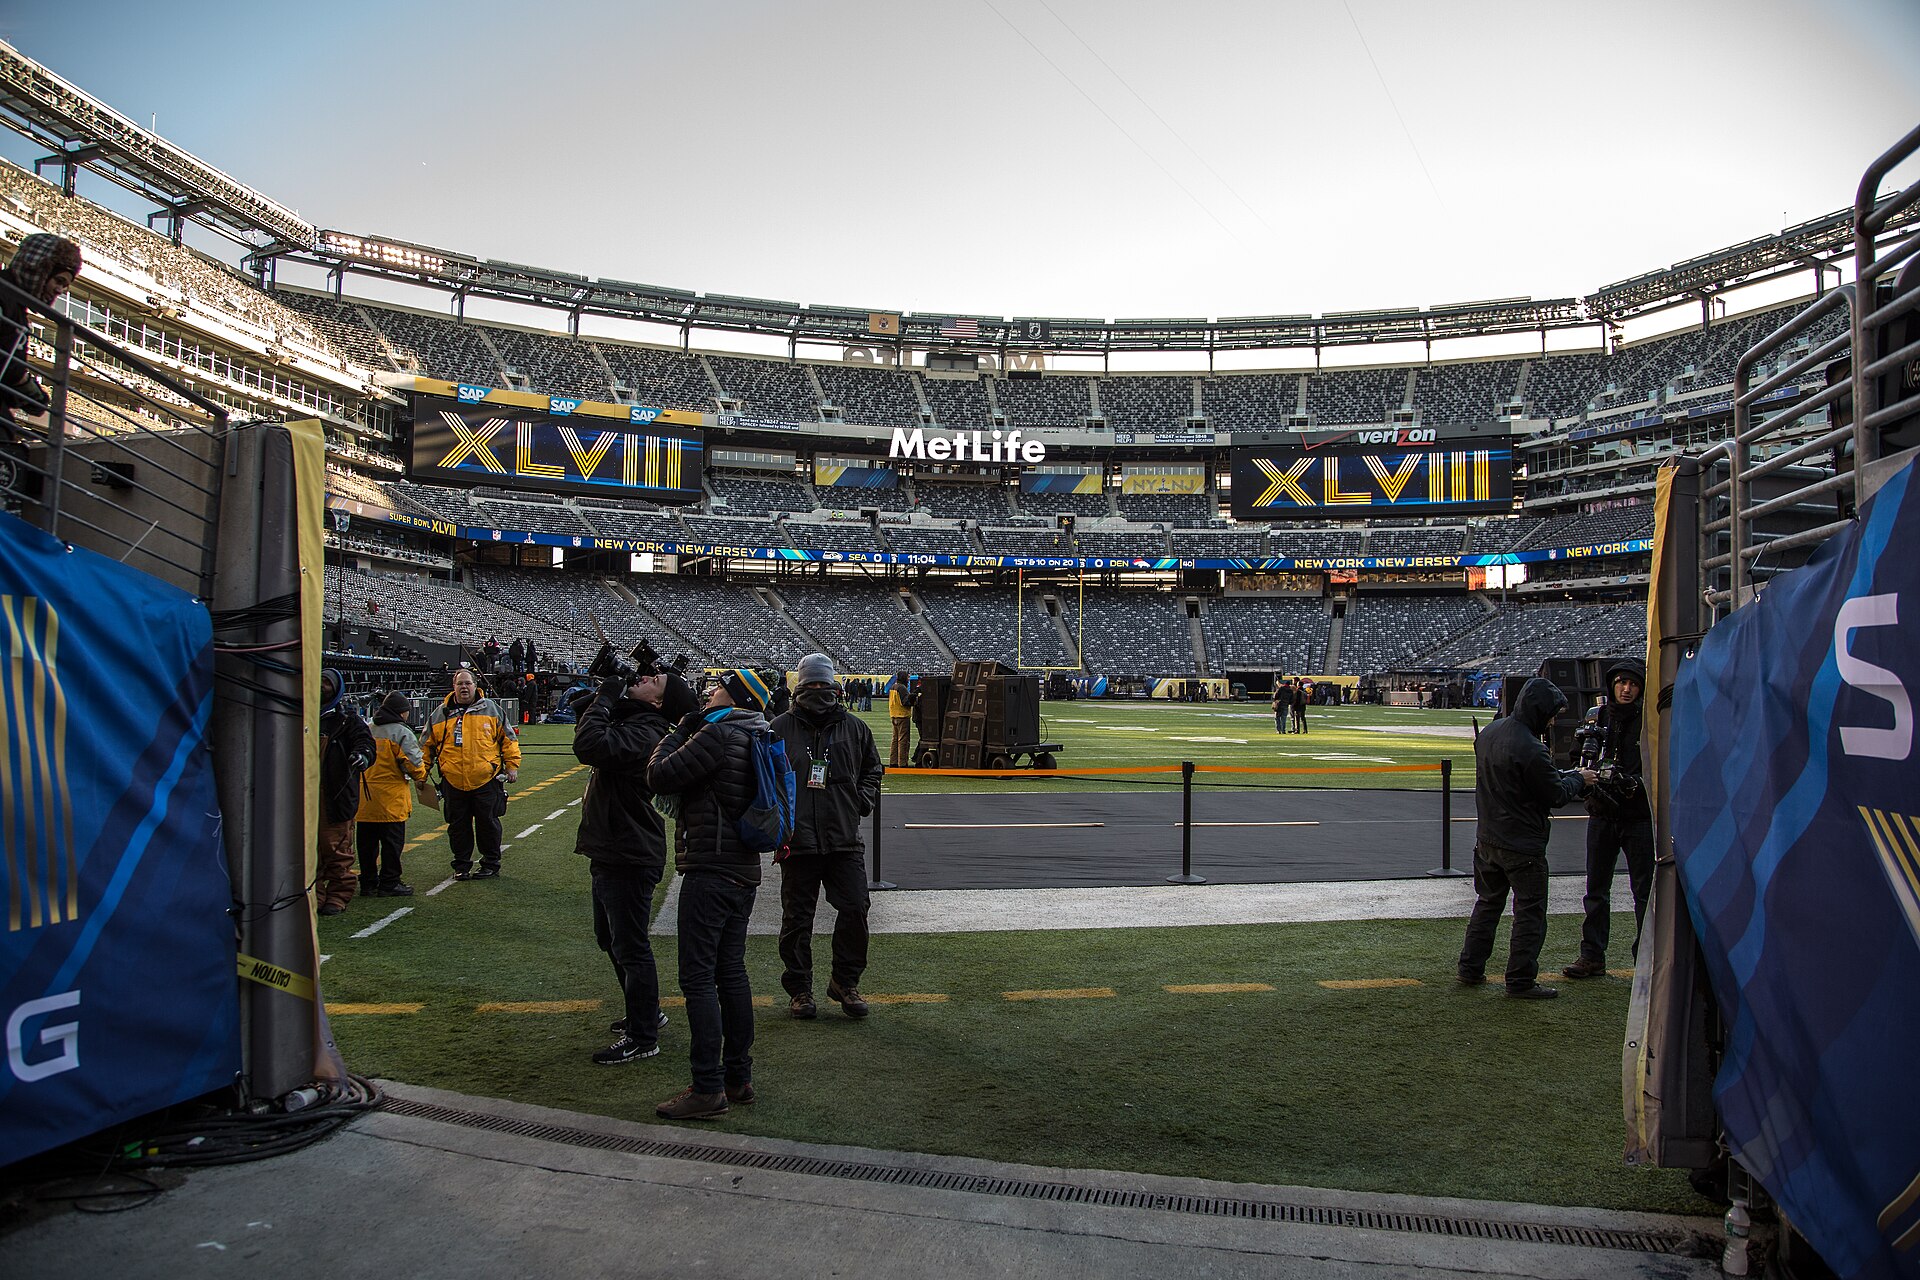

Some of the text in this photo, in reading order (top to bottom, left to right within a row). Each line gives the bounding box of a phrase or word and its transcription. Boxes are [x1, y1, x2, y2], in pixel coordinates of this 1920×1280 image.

[458, 387, 485, 401] SAP
[550, 399, 575, 412] SAP
[631, 409, 656, 422] SAP
[889, 427, 1045, 463] MetLife
[1358, 427, 1436, 446] verizon
[437, 411, 682, 490] XLVIII
[1133, 479, 1194, 491] NY NJ
[1252, 450, 1490, 507] XLVIII
[389, 512, 457, 537] SUPER BOWL XLVIII
[594, 538, 757, 558] NEW YORK NEW JERSEY
[1566, 545, 1593, 557] NEW
[1595, 541, 1629, 554] YORK
[907, 554, 937, 564] 11:04
[1014, 558, 1028, 566] 1ST
[1036, 558, 1046, 566] 10
[1110, 559, 1129, 567] DEN
[1294, 556, 1461, 569] NEW YORK NEW JERSEY
[250, 962, 291, 987] CAUTION
